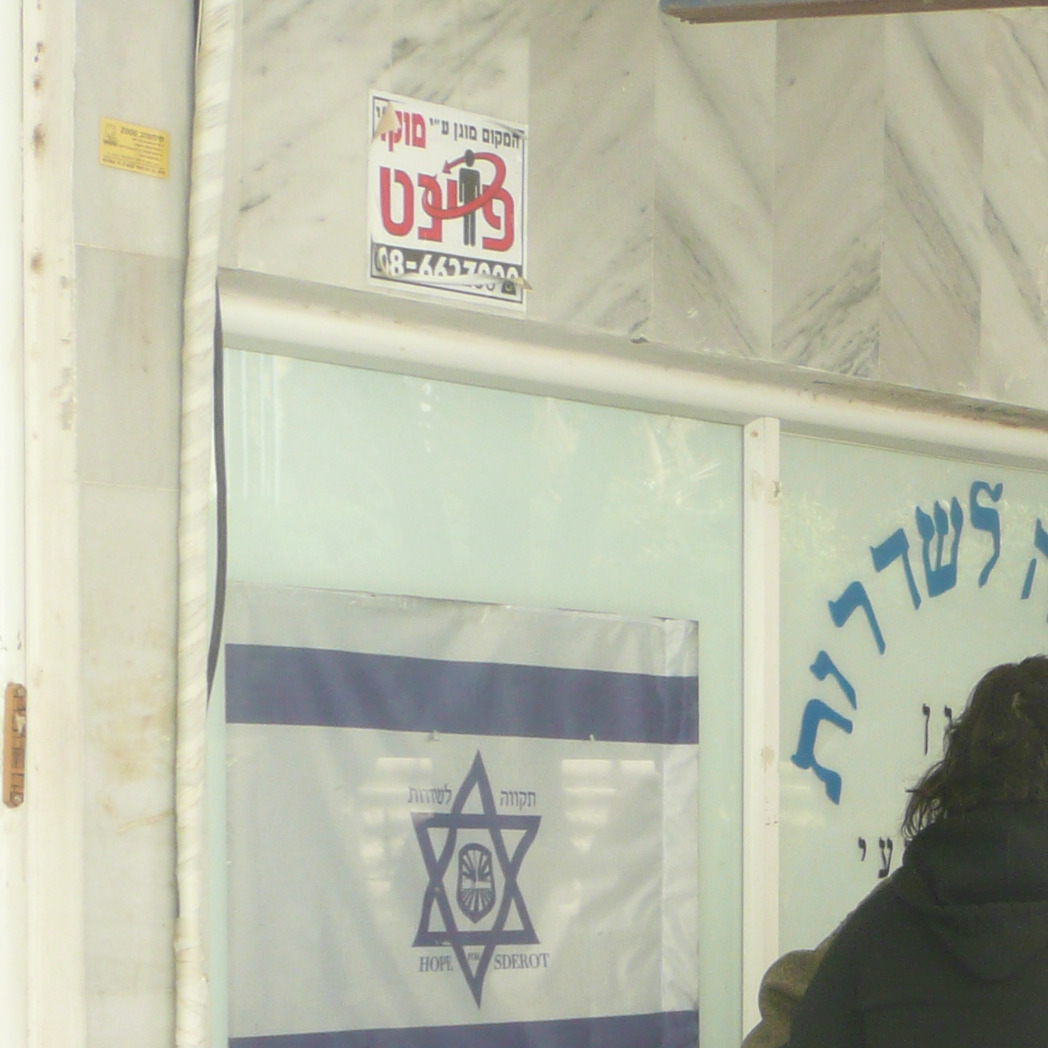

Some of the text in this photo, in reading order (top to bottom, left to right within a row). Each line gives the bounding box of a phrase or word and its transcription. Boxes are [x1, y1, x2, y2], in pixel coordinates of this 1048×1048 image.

[380, 110, 426, 152] מוק
[454, 121, 478, 141] מוגן
[482, 127, 520, 149] המקום
[791, 481, 1003, 806] לשדרות
[408, 783, 536, 811] תקווה לשדרות
[419, 955, 454, 972] HOPE
[494, 952, 550, 970] SDEROT
